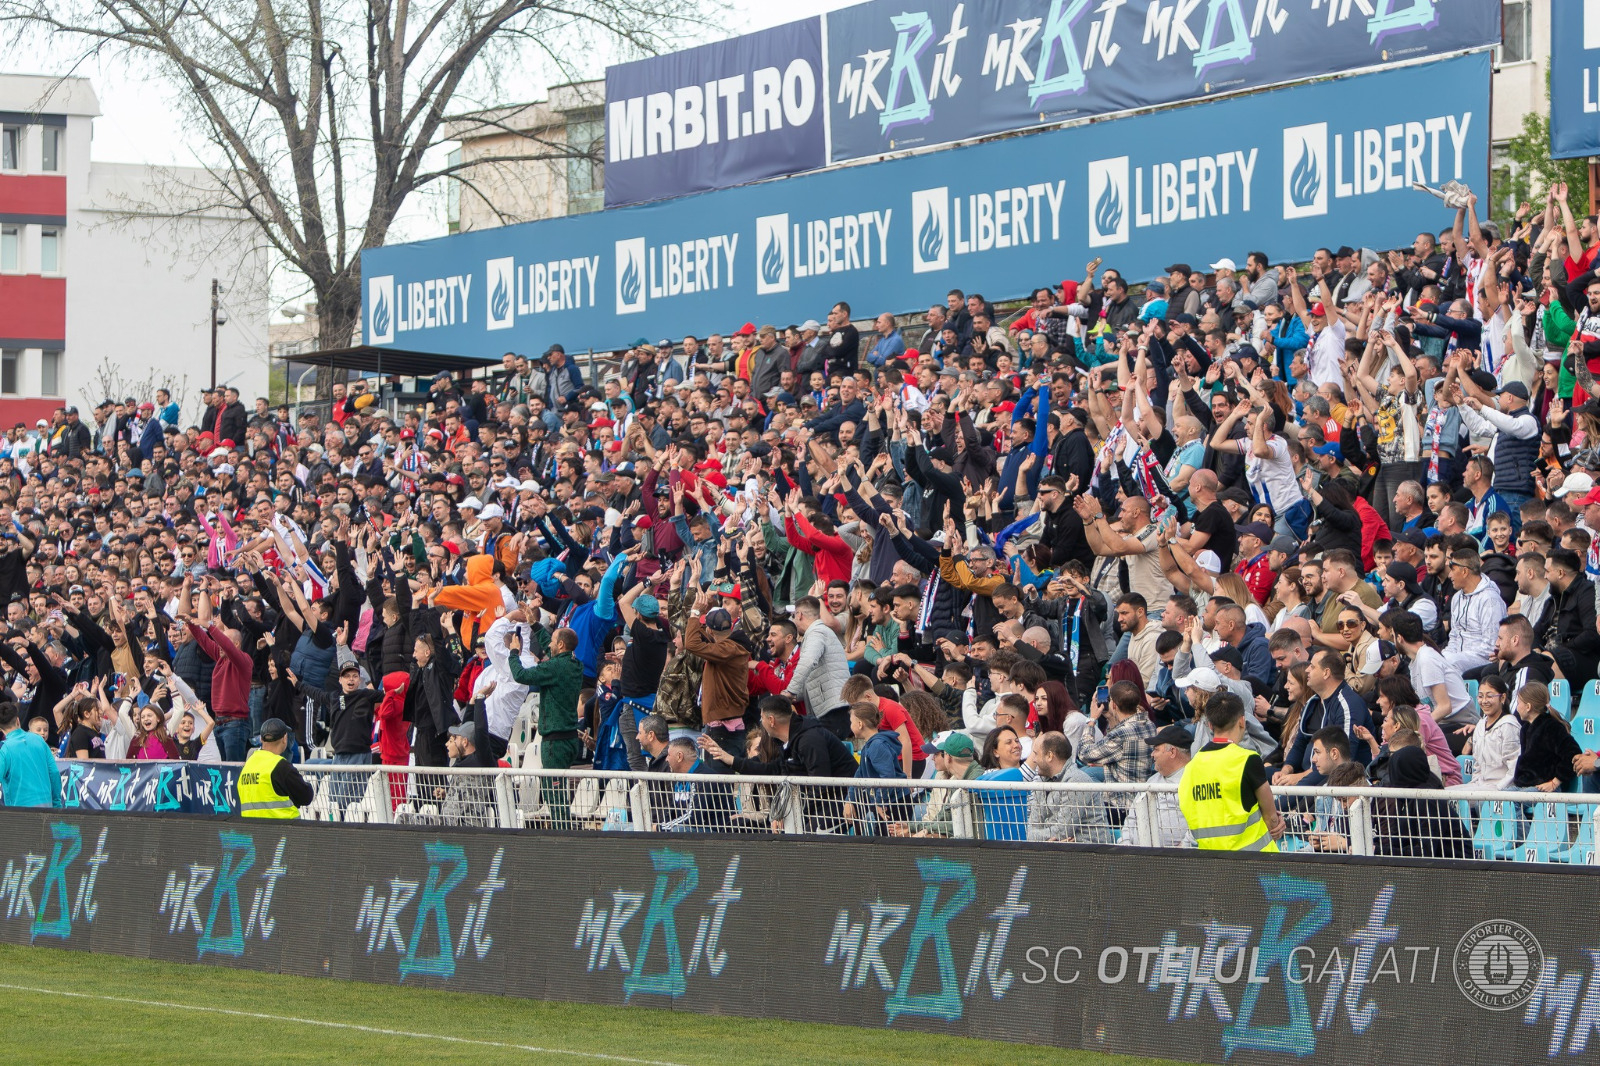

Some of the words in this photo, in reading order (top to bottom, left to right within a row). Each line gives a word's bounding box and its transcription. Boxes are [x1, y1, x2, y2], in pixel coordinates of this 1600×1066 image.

[609, 59, 816, 163] MRBIT.RO
[1136, 148, 1258, 227] LIBERTY
[1335, 112, 1472, 198] LIBERTY
[794, 209, 892, 278] LIBERTY
[954, 180, 1066, 254] LIBERTY
[518, 256, 600, 315] LIBERTY
[650, 233, 739, 299] LIBERTY
[398, 274, 472, 332] LIBERTY
[1584, 719, 1593, 734] 28
